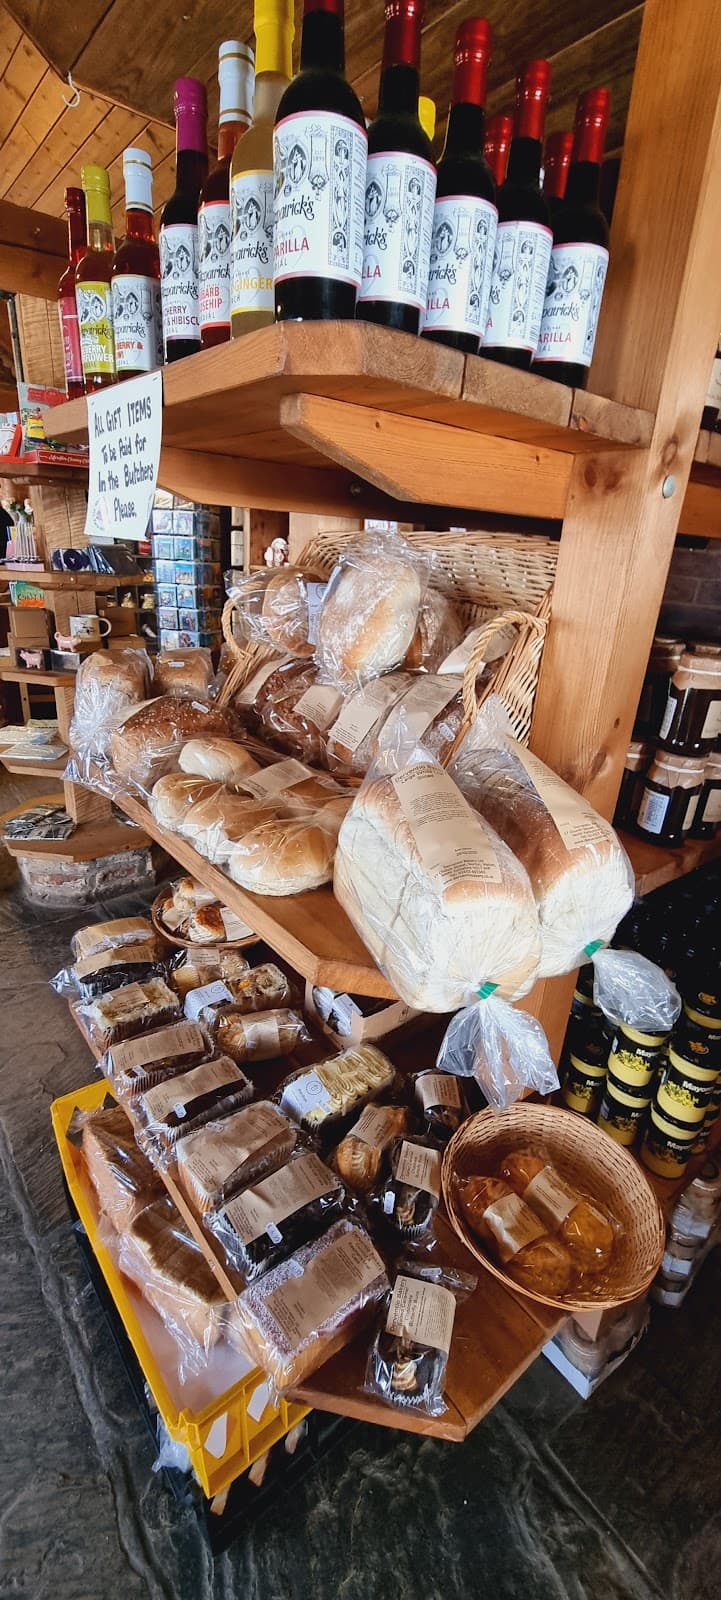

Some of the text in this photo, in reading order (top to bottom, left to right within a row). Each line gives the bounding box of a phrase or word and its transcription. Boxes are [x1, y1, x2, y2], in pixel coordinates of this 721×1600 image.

[94, 396, 152, 439] ALL GIFT ITEMS
[101, 444, 108, 465] To
[108, 443, 117, 462] be
[118, 435, 133, 460] Paid
[134, 433, 147, 454] for
[98, 462, 154, 493] In the Butchers
